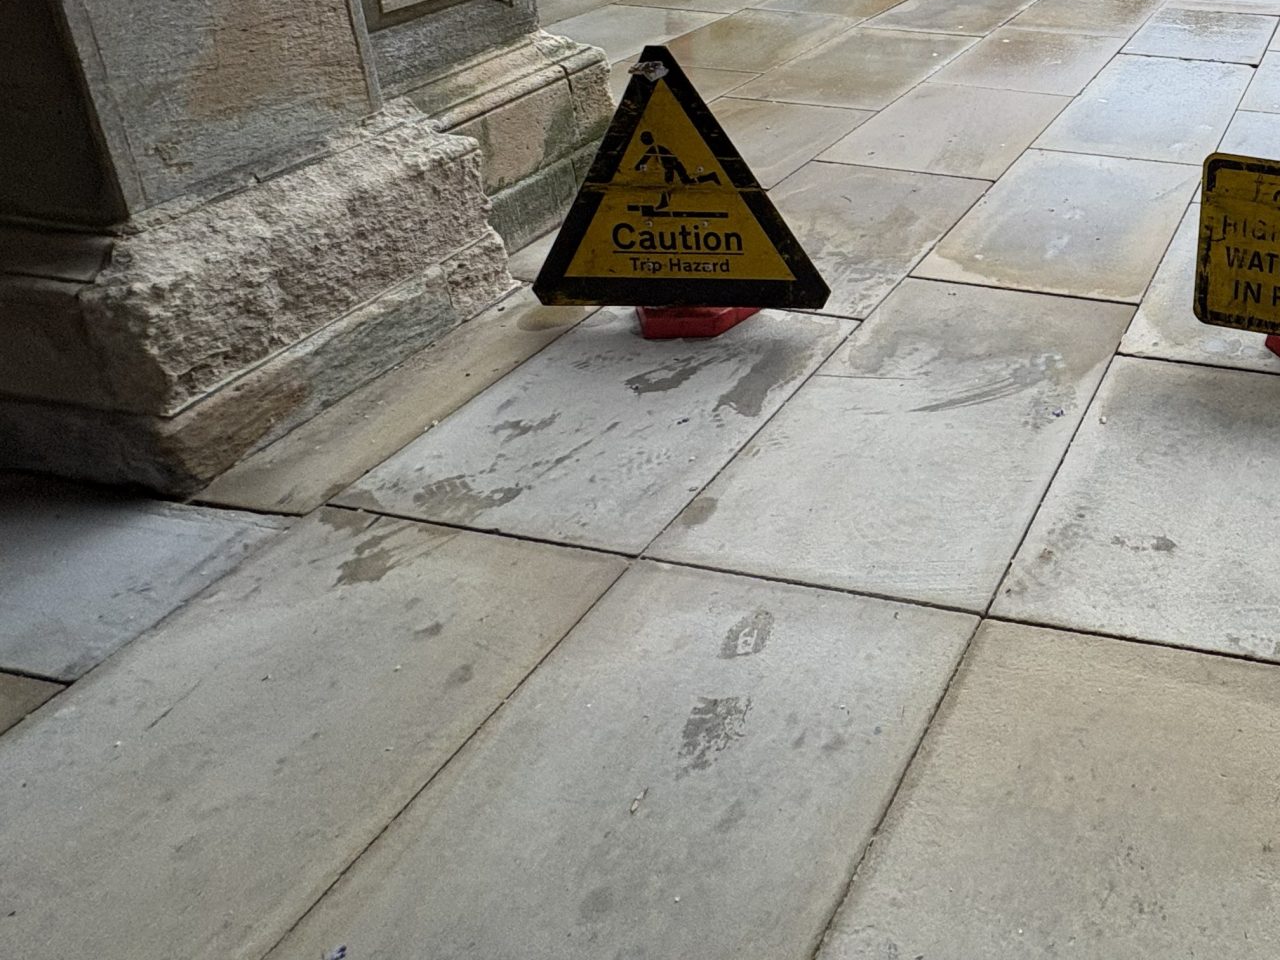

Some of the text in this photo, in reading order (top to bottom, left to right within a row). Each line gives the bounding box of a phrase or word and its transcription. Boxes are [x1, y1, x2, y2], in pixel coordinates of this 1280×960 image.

[611, 223, 743, 252] Caution
[630, 257, 730, 274] Trip Hazard
[1233, 279, 1262, 305] IN
